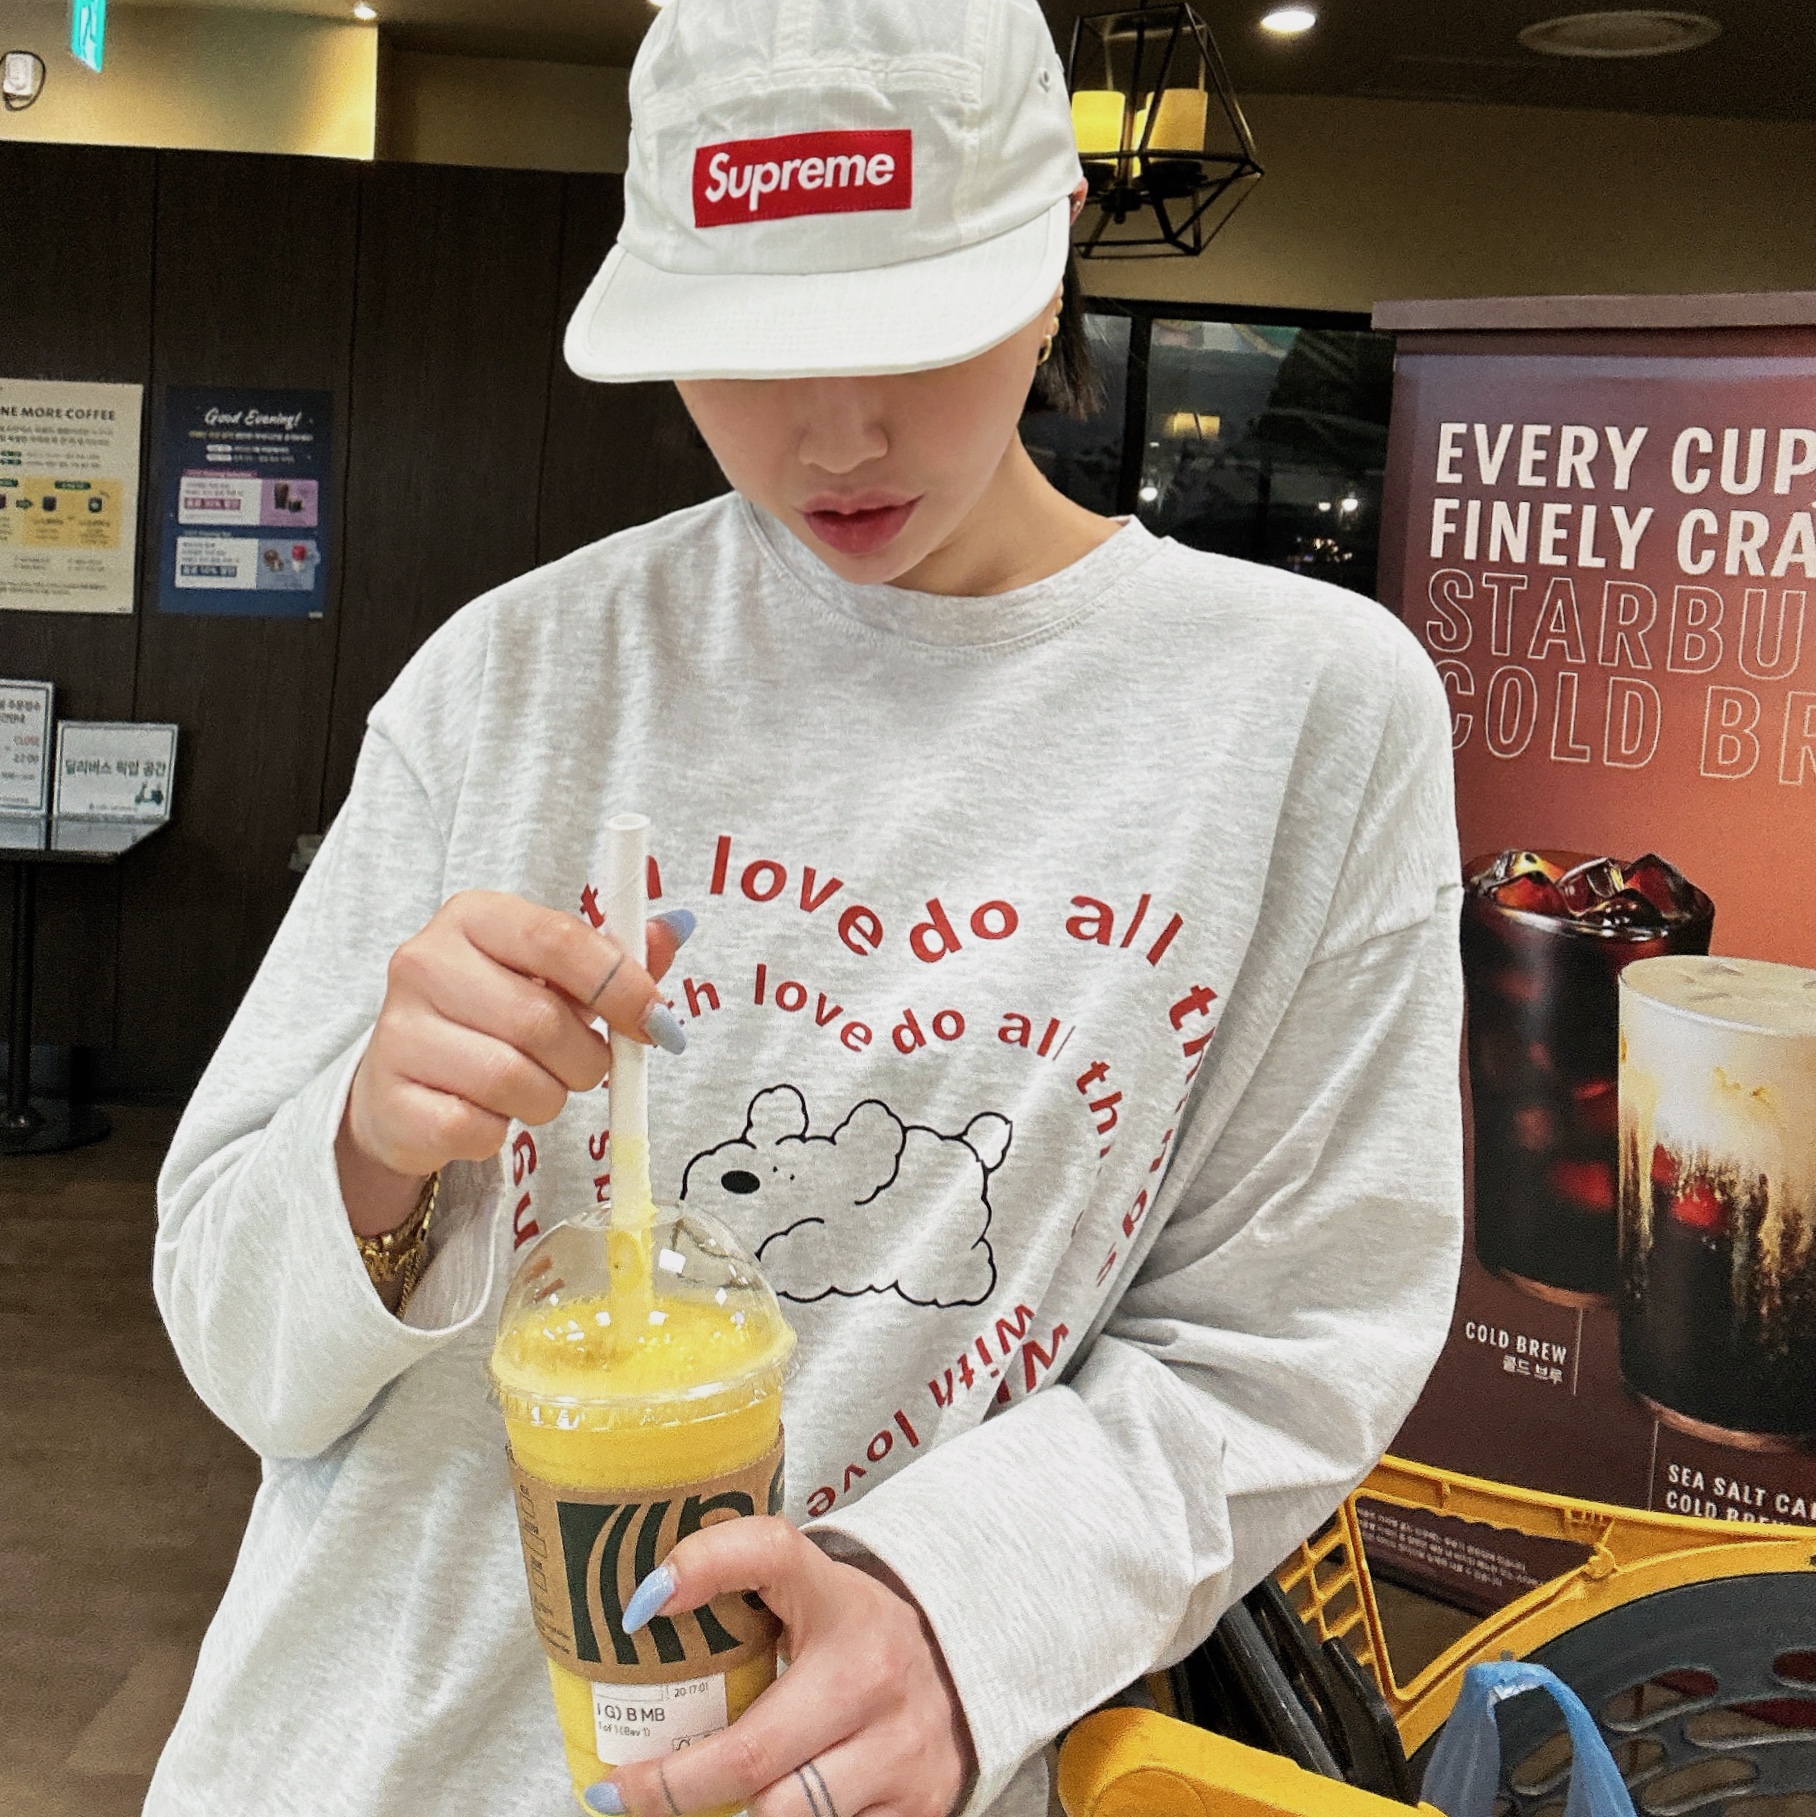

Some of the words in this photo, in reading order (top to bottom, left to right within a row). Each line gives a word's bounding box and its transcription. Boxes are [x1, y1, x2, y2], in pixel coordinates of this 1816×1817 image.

[704, 151, 896, 212] Supreme
[21, 406, 63, 419] MORE
[65, 408, 117, 421] COFFEE
[204, 406, 242, 427] Good
[244, 409, 302, 431] Evening!
[1435, 421, 1649, 491] EVERY
[1429, 497, 1655, 571] FINELY
[1676, 507, 1816, 578] CRA
[1425, 567, 1808, 682] STARBU
[1434, 659, 1662, 770] COLD
[116, 759, 140, 777] 픽업
[143, 760, 167, 778] 공간
[709, 834, 884, 957] love
[909, 897, 1019, 964] do
[1065, 893, 1184, 967] all
[753, 962, 873, 1053] love
[892, 1007, 966, 1055] do
[928, 1303, 1035, 1409] with
[1465, 1321, 1510, 1349] COLD
[1516, 1335, 1567, 1365] BREW
[1503, 1354, 1531, 1375] 콜드
[1534, 1363, 1563, 1385] 브루
[806, 1408, 920, 1518] love
[1668, 1463, 1705, 1491] SEA
[1713, 1476, 1766, 1507] SALT
[1665, 1490, 1718, 1520] COLD
[640, 1707, 666, 1722] MB
